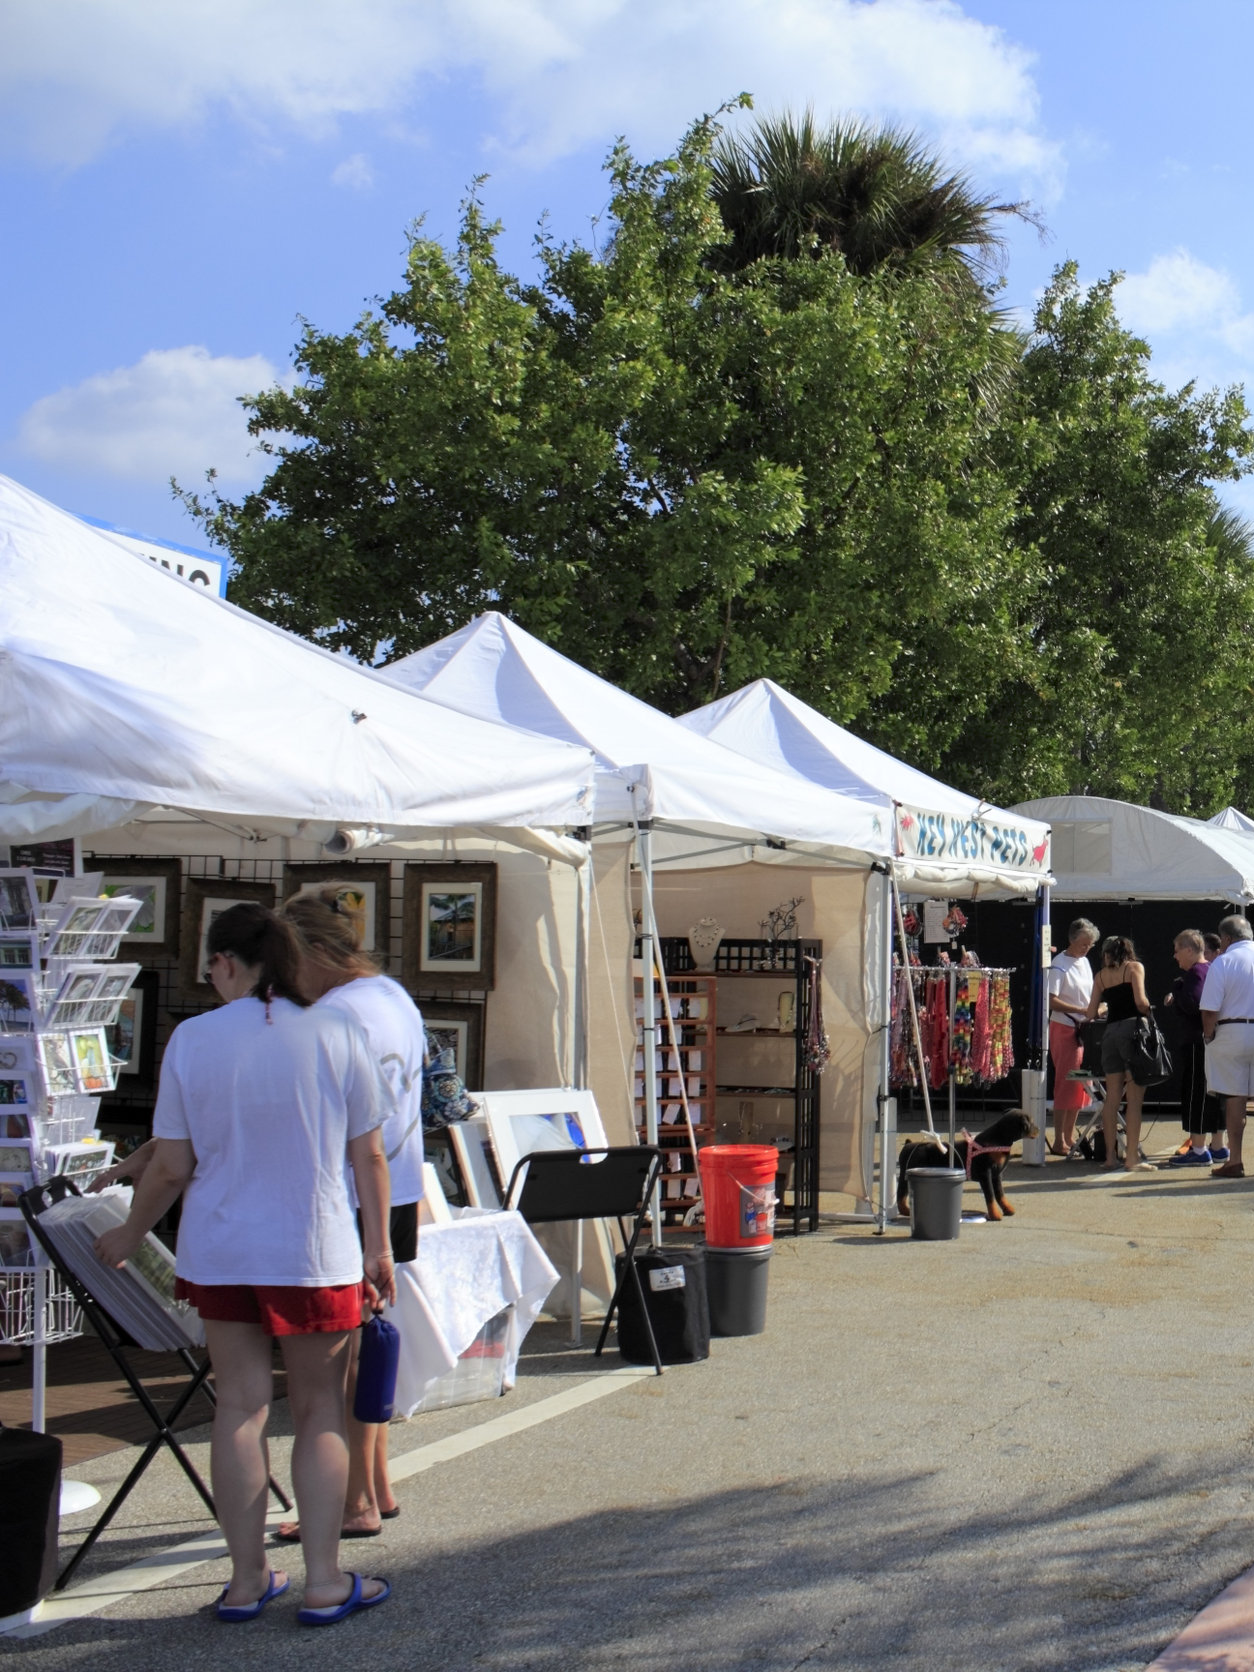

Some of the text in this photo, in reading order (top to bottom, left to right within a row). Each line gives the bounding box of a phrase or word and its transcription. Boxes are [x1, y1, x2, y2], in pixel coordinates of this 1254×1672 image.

[917, 812, 1028, 867] KEY WEST PETS
